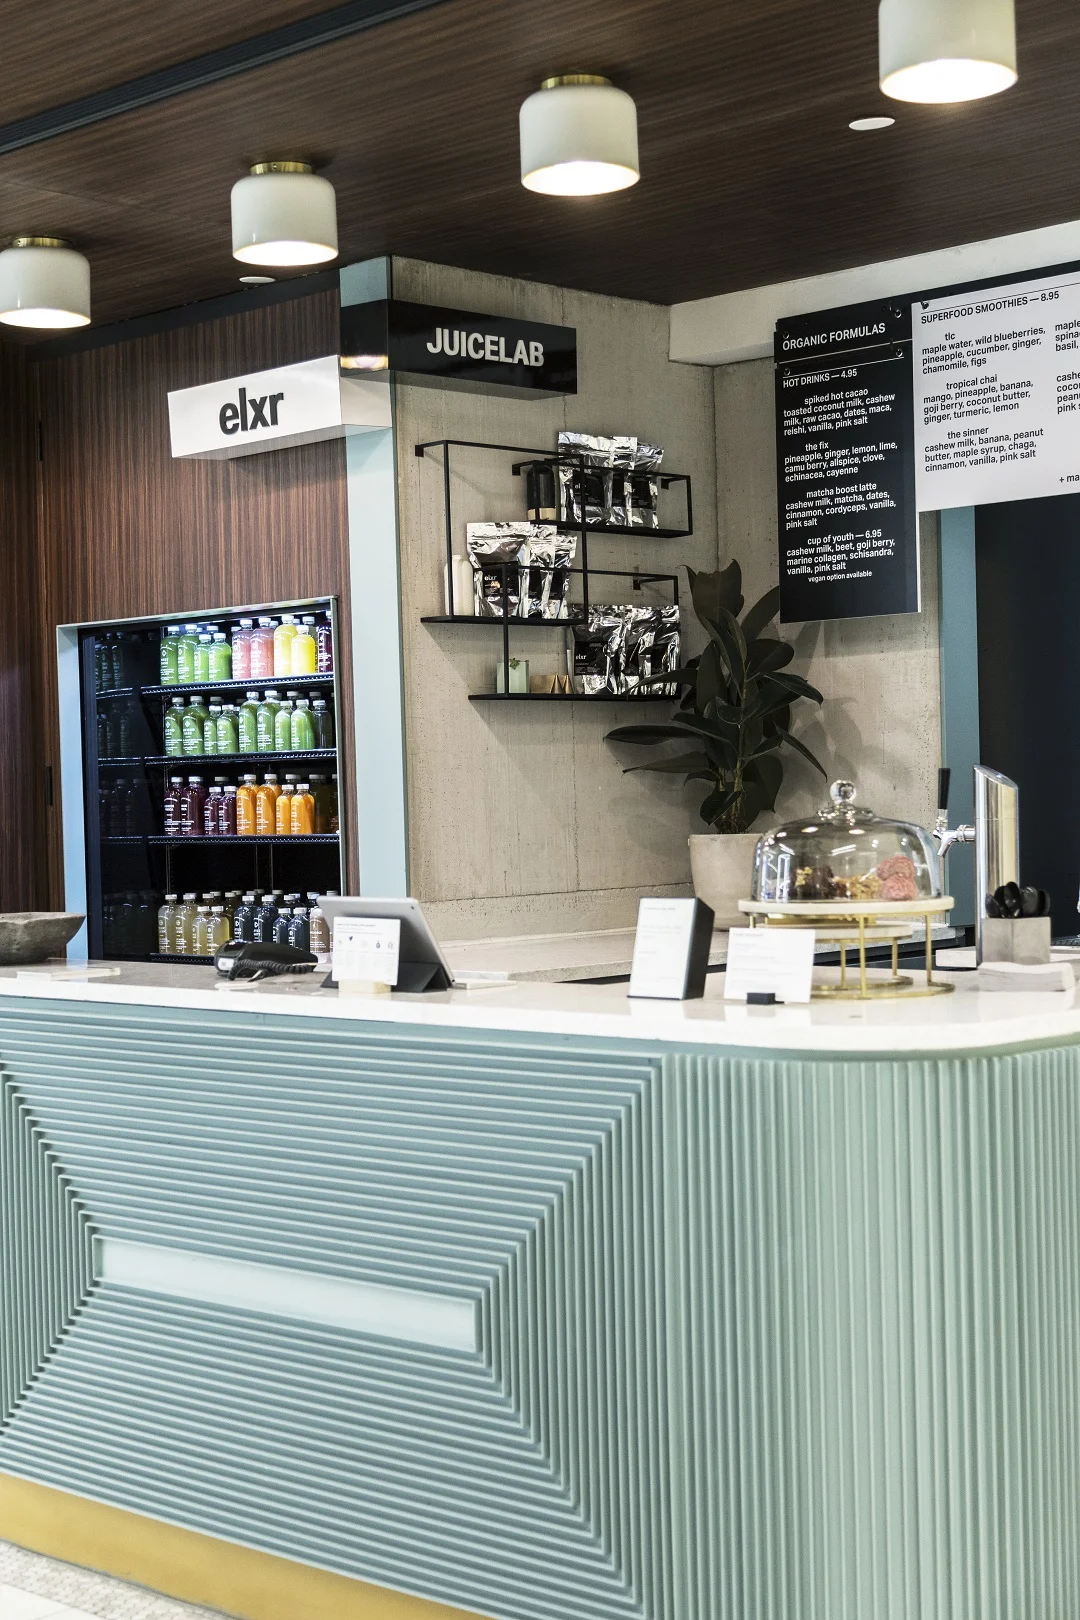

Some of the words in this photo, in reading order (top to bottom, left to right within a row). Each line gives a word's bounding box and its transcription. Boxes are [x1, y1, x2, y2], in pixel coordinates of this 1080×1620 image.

[921, 308, 973, 324] SUPERFOOD
[976, 297, 1028, 314] SMOOTHIES
[1041, 291, 1059, 301] 8.95
[783, 334, 827, 350] ORGANIC
[830, 323, 885, 342] FORMULAS
[922, 344, 946, 355] maple
[949, 339, 973, 350] water,
[975, 336, 992, 345] wild
[994, 327, 1046, 342] blueberries,
[1056, 331, 1080, 342] spina
[1056, 340, 1078, 351] basil,
[427, 328, 544, 367] JUICELAB
[923, 351, 964, 366] pineapple,
[967, 344, 1009, 357] cucumber,
[1012, 337, 1041, 350] ginger,
[923, 361, 968, 374] chamomile,
[971, 357, 986, 367] figs
[783, 378, 799, 388] HOT
[801, 374, 829, 385] DRINKS
[841, 369, 857, 378] 4.95
[946, 376, 978, 390] tropical
[980, 374, 997, 384] chai
[804, 394, 829, 405] spiked
[846, 389, 868, 398] cacao
[924, 394, 953, 405] mango,
[955, 386, 998, 400] pineapple,
[1000, 380, 1033, 391] banana,
[219, 388, 283, 435] elxr
[784, 406, 812, 417] toasted
[814, 403, 844, 413] coconut
[846, 398, 864, 408] milk,
[866, 394, 895, 404] cashew
[924, 404, 939, 415] goji
[941, 400, 964, 411] berry,
[967, 395, 1001, 406] coconut
[1003, 390, 1030, 400] butter,
[1058, 403, 1076, 414] pink
[784, 417, 801, 426] milk,
[818, 411, 842, 421] cacao,
[844, 407, 867, 417] dates,
[869, 404, 892, 413] maca,
[924, 414, 951, 425] ginger,
[954, 407, 991, 418] turmeric,
[993, 402, 1019, 412] lemon
[784, 425, 806, 436] reishi,
[808, 421, 834, 432] vanilla,
[836, 418, 852, 430] pink
[854, 416, 868, 425] salt
[948, 431, 960, 439] the
[963, 427, 989, 437] sinner
[805, 443, 818, 452] the
[925, 442, 955, 452] cashew
[958, 438, 976, 448] milk,
[979, 434, 1011, 445] banana,
[1014, 428, 1043, 441] peanut
[785, 452, 823, 465] pineapple,
[825, 449, 850, 460] ginger,
[852, 445, 877, 455] lemon,
[880, 442, 897, 451] lime,
[925, 452, 951, 462] butter,
[954, 447, 978, 458] maple
[980, 445, 1006, 455] syrup,
[1009, 440, 1036, 451] chaga,
[785, 464, 805, 473] camu
[807, 460, 828, 471] berry,
[830, 457, 860, 469] allspice,
[863, 453, 884, 462] clove,
[925, 461, 966, 472] cinnamon,
[969, 455, 998, 466] vanilla,
[1000, 452, 1018, 463] pink
[1020, 450, 1036, 459] salt
[785, 471, 825, 482] echinacea,
[826, 466, 858, 477] cayenne
[807, 488, 834, 498] matcha
[836, 485, 858, 494] boost
[860, 482, 876, 491] latte
[786, 500, 814, 510] cashew
[815, 497, 832, 506] milk,
[834, 494, 864, 504] matcha,
[866, 491, 890, 500] dates,
[786, 509, 824, 519] cinnamon,
[826, 503, 867, 515] cordyceps,
[869, 500, 896, 509] vanilla,
[786, 519, 802, 530] pink
[787, 546, 814, 556] cashew
[816, 544, 834, 553] milk,
[836, 541, 855, 550] beet,
[857, 540, 871, 550] goji
[872, 538, 895, 549] berry,
[808, 537, 821, 546] cup
[832, 532, 854, 544] youth
[866, 529, 881, 538] 6.95
[787, 556, 812, 565] marine
[814, 552, 848, 564] collagen,
[850, 548, 894, 559] schisandra,
[787, 565, 812, 575] vanilla,
[815, 562, 830, 573] pink
[832, 562, 846, 570] salt
[808, 575, 825, 583] vegan
[827, 572, 845, 581] option
[846, 570, 872, 578] available
